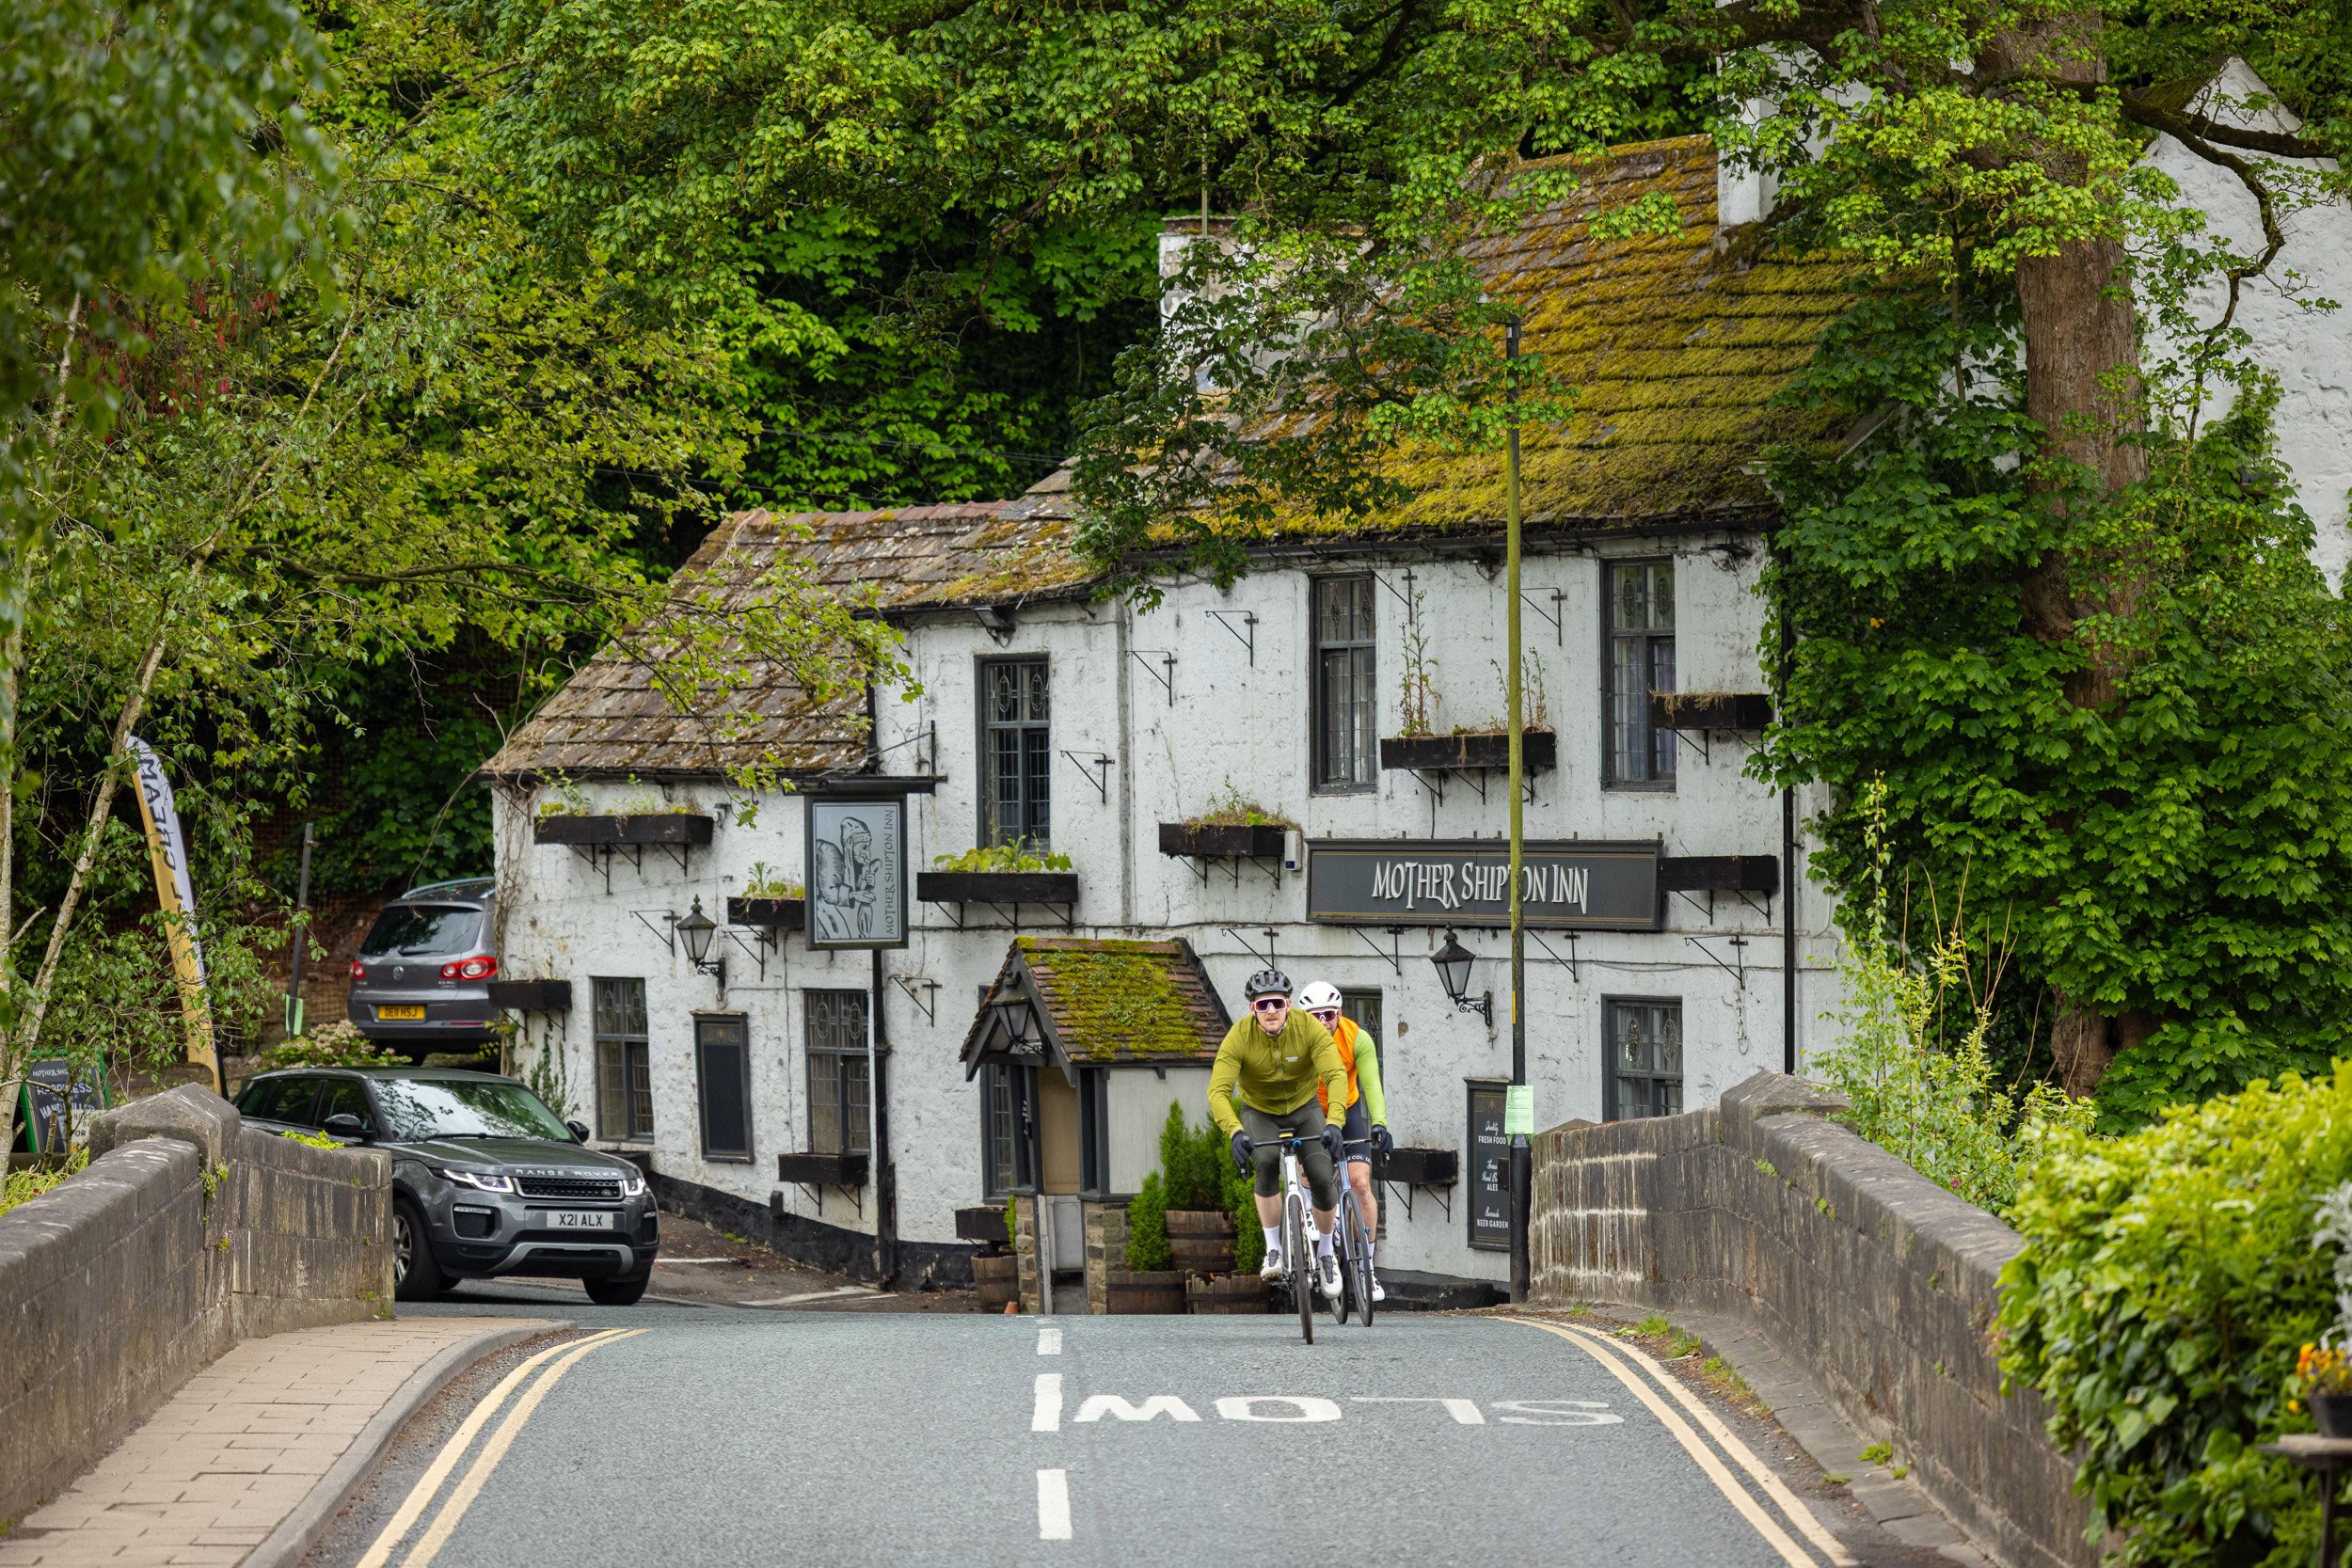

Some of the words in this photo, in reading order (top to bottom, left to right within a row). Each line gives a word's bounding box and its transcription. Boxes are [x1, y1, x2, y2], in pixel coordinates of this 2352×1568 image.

[884, 809, 896, 830] INN
[884, 833, 896, 882] SHIPTON
[1372, 861, 1462, 910] MOTHER
[1461, 862, 1548, 912] SHIPON
[1551, 863, 1589, 914] INN
[884, 883, 896, 935] MOTHER
[1478, 1135, 1493, 1145] FRESH
[1493, 1136, 1507, 1145] FOOD
[1486, 1183, 1499, 1192] ALES
[559, 1213, 578, 1227] X21
[580, 1213, 603, 1227] ALX
[1476, 1218, 1489, 1227] BEER
[1488, 1219, 1509, 1229] GARDEN
[1073, 1394, 1625, 1425] SLOW
